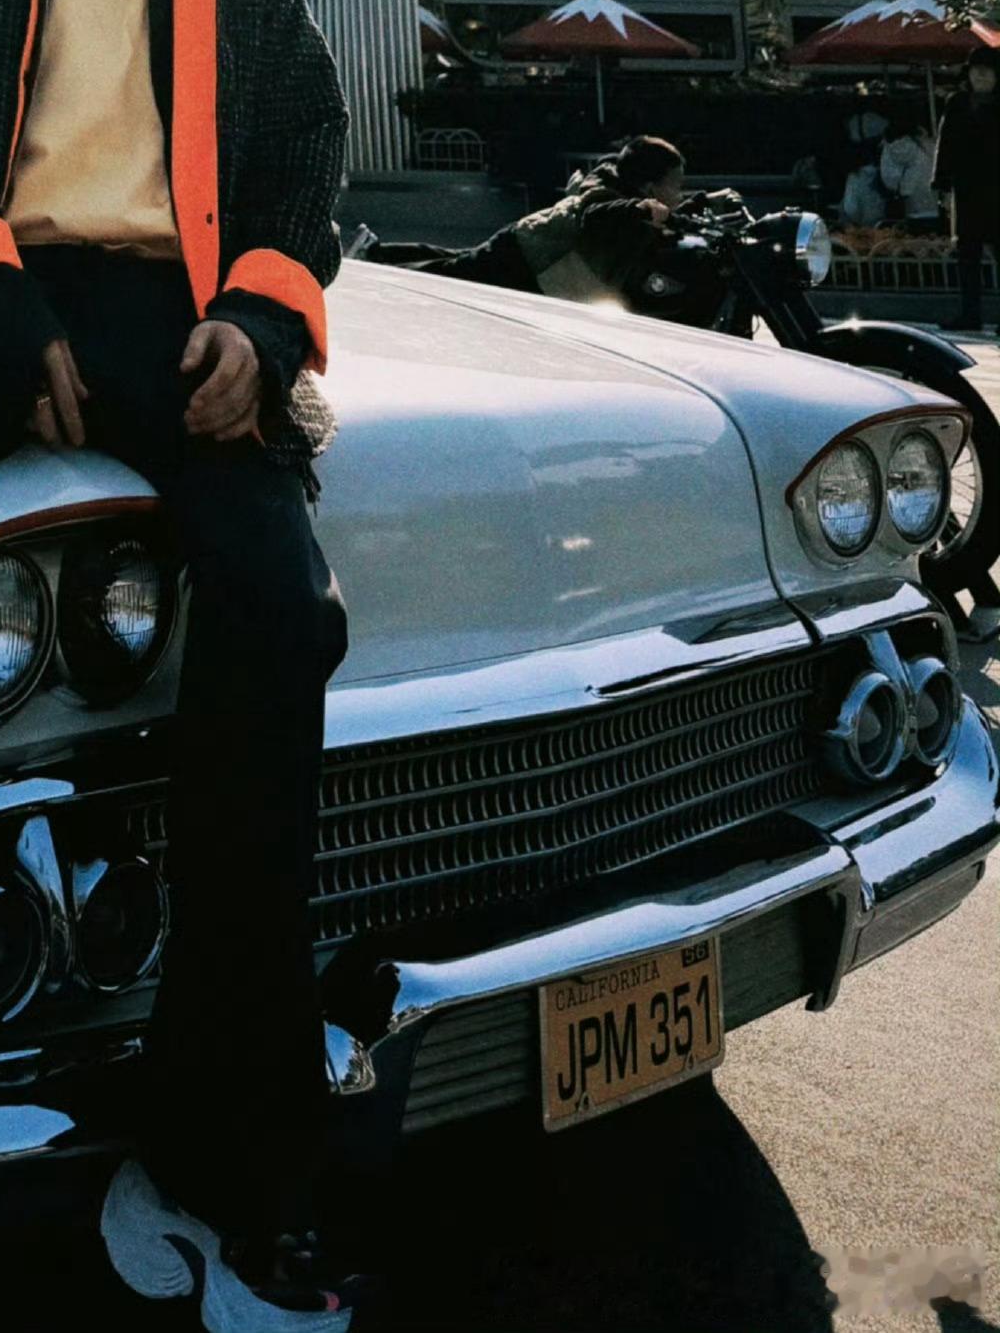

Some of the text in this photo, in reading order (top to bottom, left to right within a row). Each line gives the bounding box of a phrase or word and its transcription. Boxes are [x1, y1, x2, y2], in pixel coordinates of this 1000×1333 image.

[555, 959, 661, 1012] CALIFORNIA
[557, 974, 712, 1102] JPM 351
